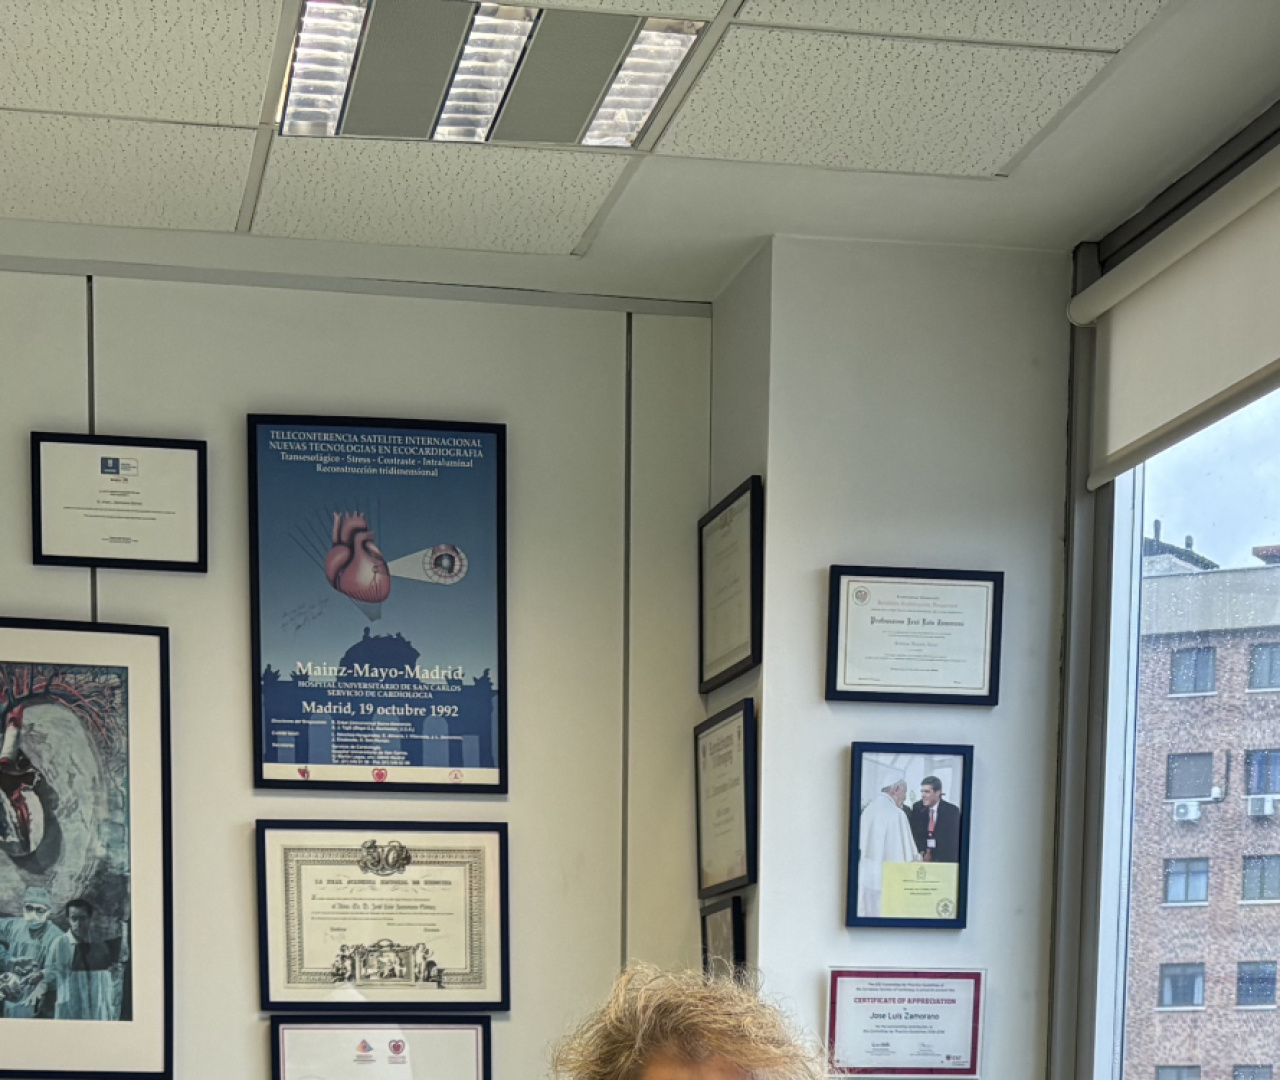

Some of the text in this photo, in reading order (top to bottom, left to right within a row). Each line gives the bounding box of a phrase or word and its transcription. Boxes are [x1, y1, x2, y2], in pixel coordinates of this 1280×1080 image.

[269, 430, 483, 448] TELECONFERENCIA SATELITE INTERNACIONAL
[269, 441, 484, 458] NUEVAS TECNOLOGIAS EN ECOCARDIOGRAFIA
[346, 454, 371, 464] Stress
[377, 455, 416, 466] Contraste
[422, 457, 473, 467] Intraluminal
[379, 466, 439, 477] tridimensional
[295, 661, 464, 682] Mainz-Mayo-Madrid
[298, 680, 462, 693] HOSPITAL UNIVERSITARIO DE SAN CARLOS
[327, 689, 364, 697] SERVICIO
[378, 691, 433, 699] CARDIOLOGIA
[301, 701, 459, 718] Madrid, 19 octubre 1992
[907, 997, 956, 1005] APPRECIATION
[888, 1012, 901, 1020] Luis
[904, 1012, 939, 1020] Zamorano
